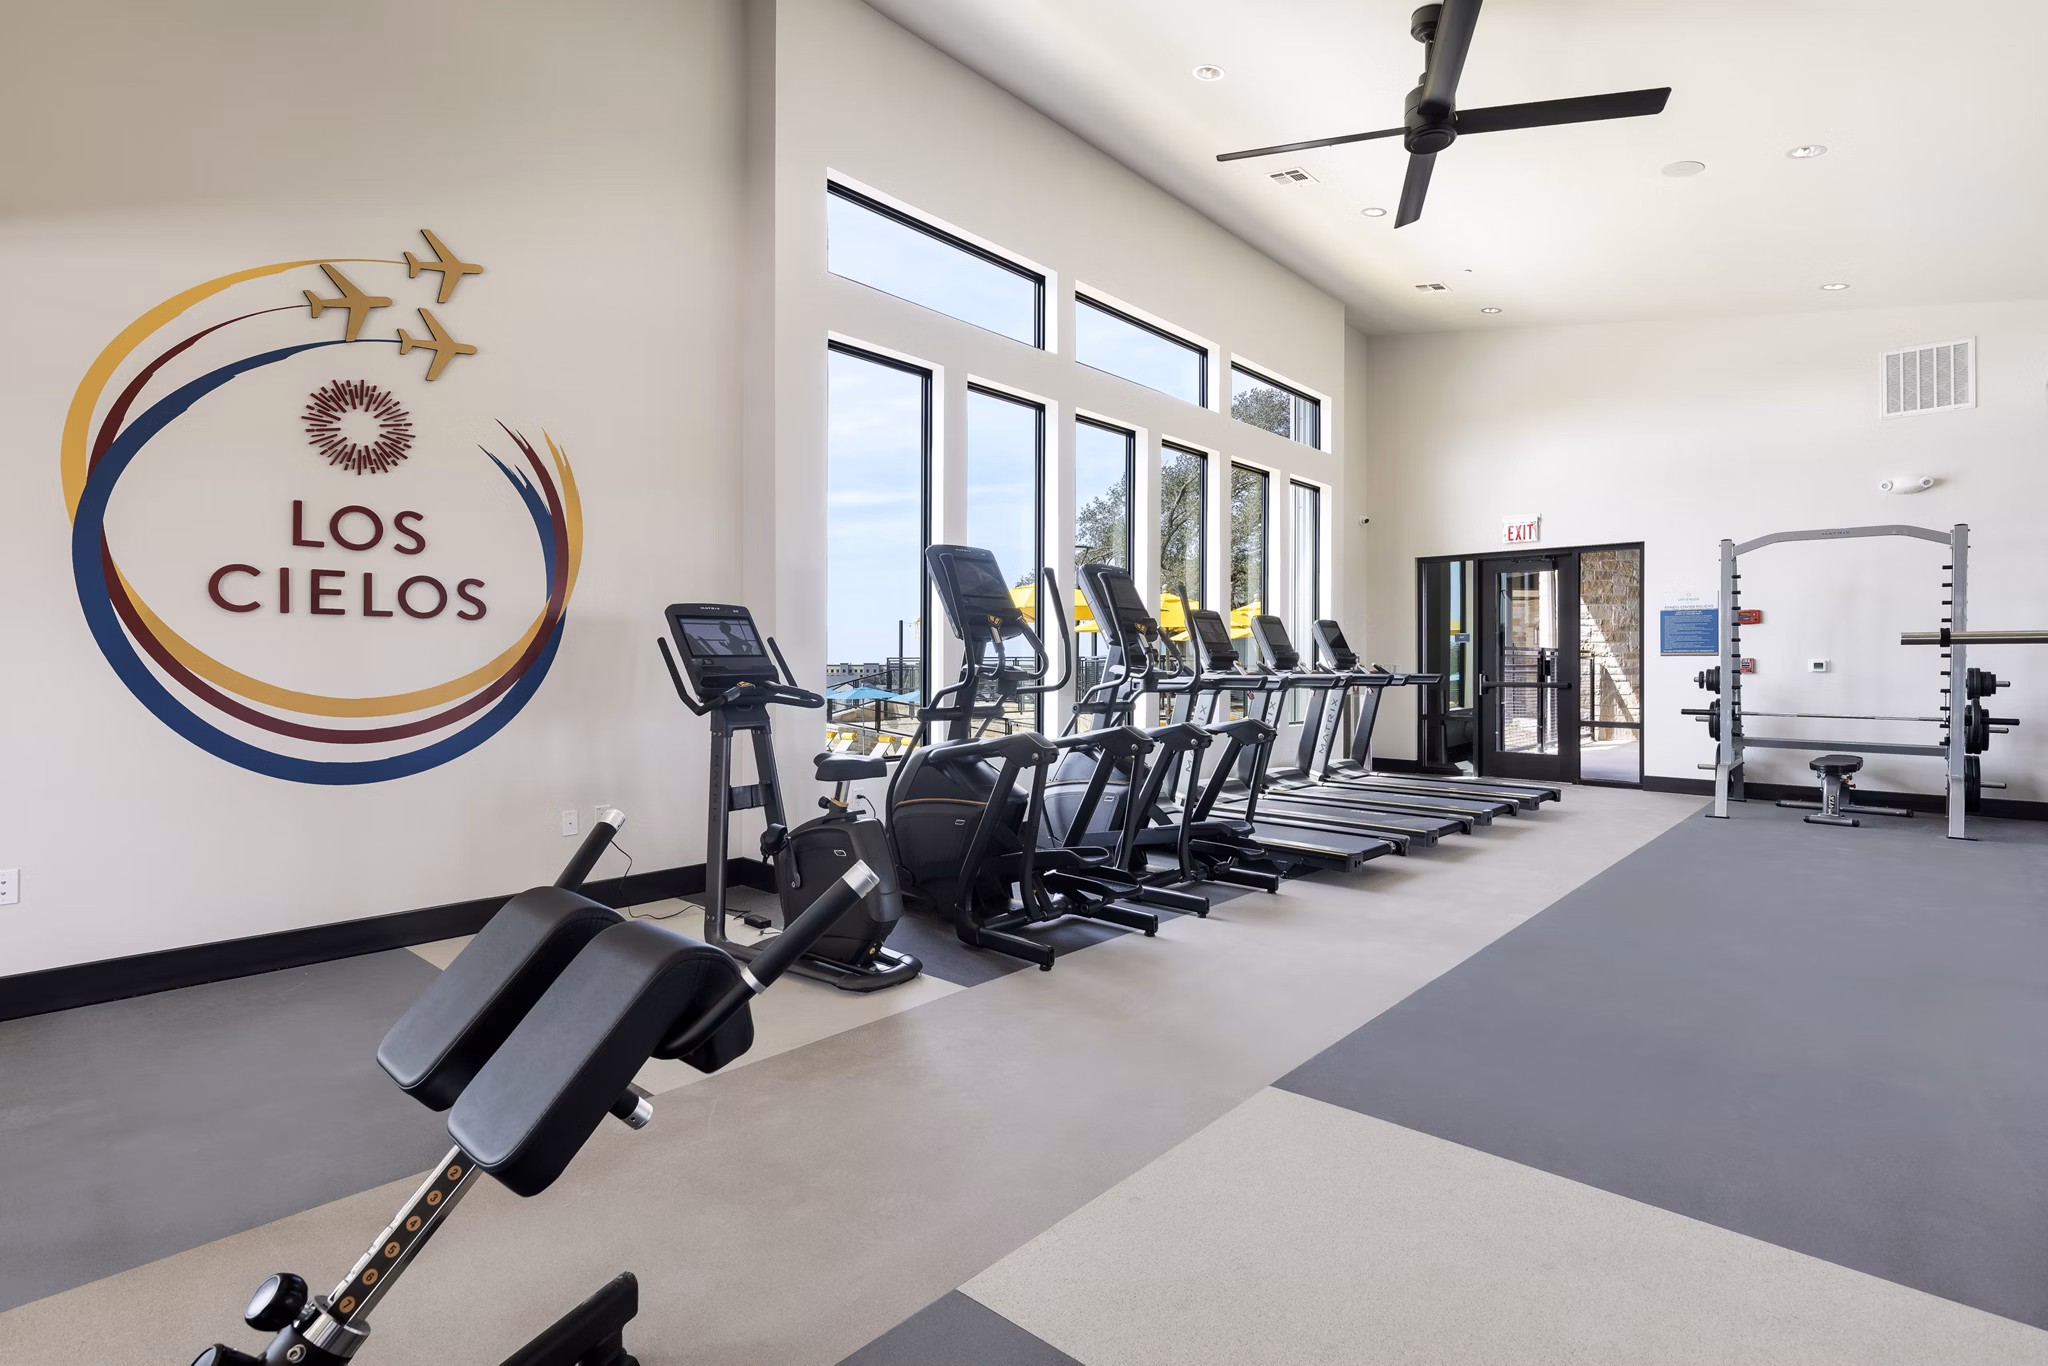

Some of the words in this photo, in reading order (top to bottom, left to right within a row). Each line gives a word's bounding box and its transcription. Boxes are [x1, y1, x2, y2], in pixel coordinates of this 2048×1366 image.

[292, 499, 426, 555] LOS
[1507, 523, 1535, 541] EXIT
[208, 563, 487, 621] CIELOS
[1319, 698, 1339, 755] MATRIX
[711, 754, 720, 823] MATRIX
